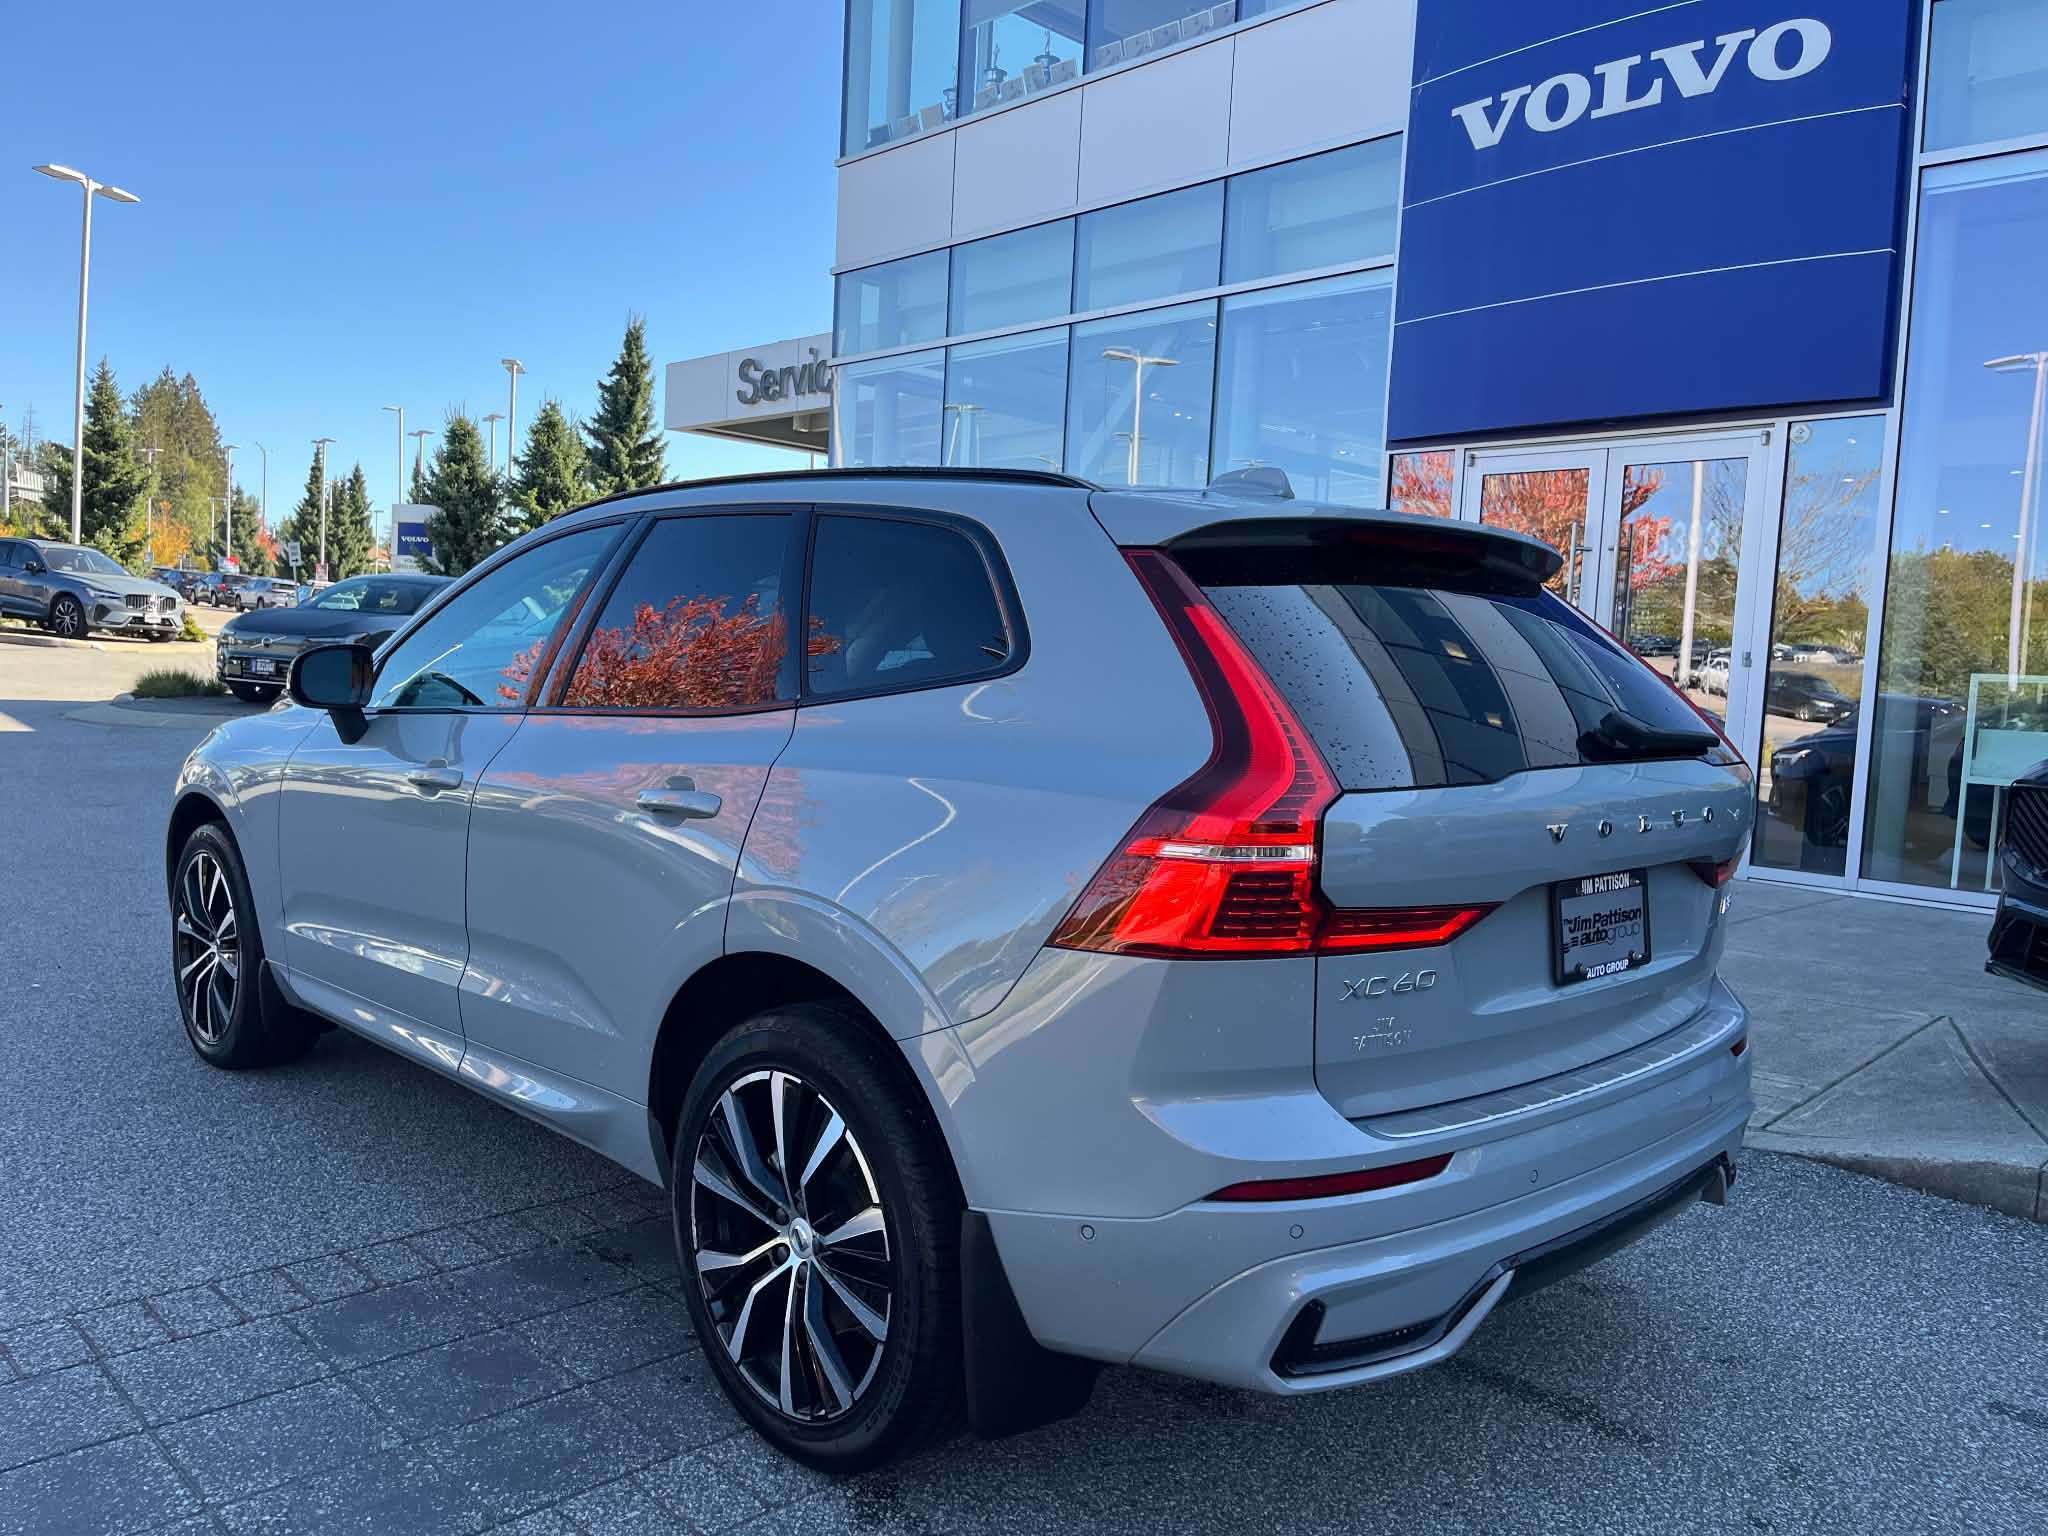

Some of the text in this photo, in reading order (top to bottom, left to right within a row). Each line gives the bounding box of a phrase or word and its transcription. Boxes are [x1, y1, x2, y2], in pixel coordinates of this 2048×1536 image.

[1451, 18, 1832, 150] VOLVO
[400, 535, 430, 543] VOLVO
[1640, 519, 1720, 565] 1533
[1546, 807, 1714, 841] VOLVO
[1581, 872, 1630, 896] JIM PATTISON
[1339, 969, 1437, 1001] XC60
[1586, 959, 1629, 979] AUTO GROUP
